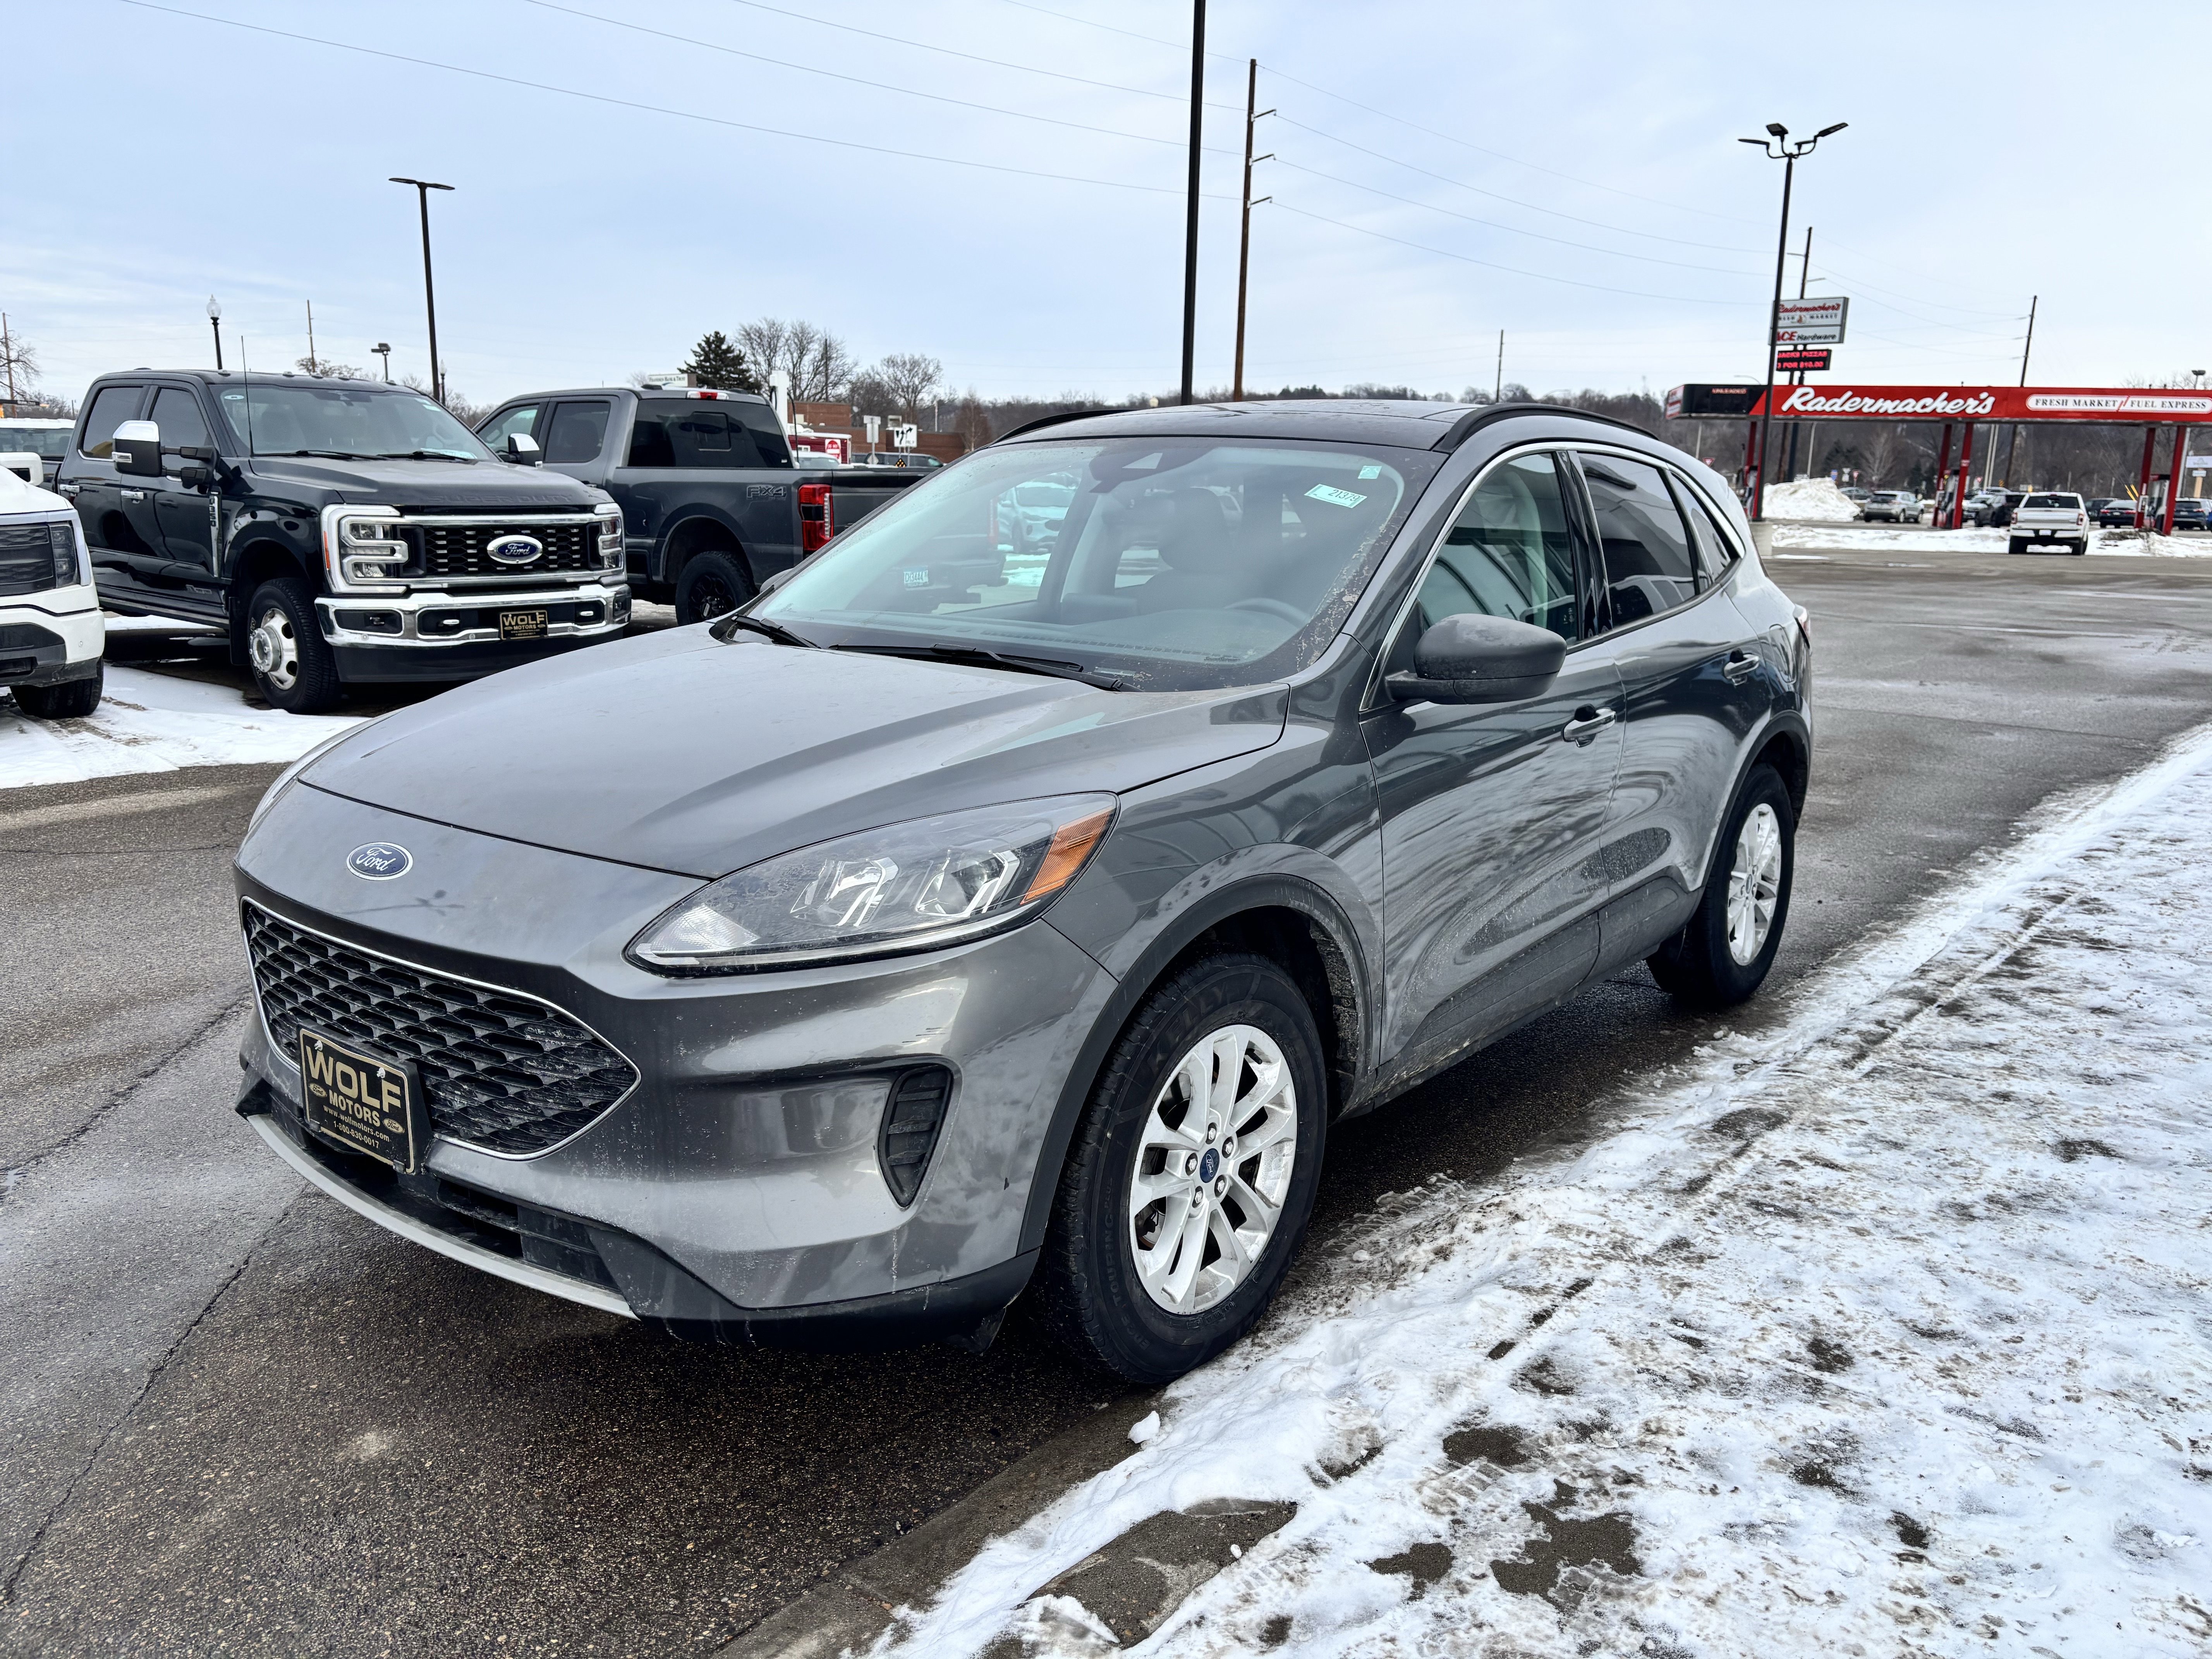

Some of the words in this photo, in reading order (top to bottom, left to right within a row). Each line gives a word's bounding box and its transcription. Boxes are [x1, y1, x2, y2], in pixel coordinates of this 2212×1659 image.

[1781, 387, 1996, 414] Radermacher's
[2073, 399, 2118, 407] MARKET
[2161, 401, 2207, 409] EXPRESS
[516, 494, 573, 503] DUTY
[747, 485, 787, 500] FX4
[1328, 489, 1361, 502] 21379
[505, 543, 530, 555] Ford
[503, 614, 544, 626] WOLF
[356, 847, 397, 871] Ford
[306, 1045, 401, 1113] WOLF
[329, 1089, 380, 1127] MOTORS
[323, 1105, 390, 1142] www.wolfmotors.com
[1104, 1214, 1122, 1307] TOURING
